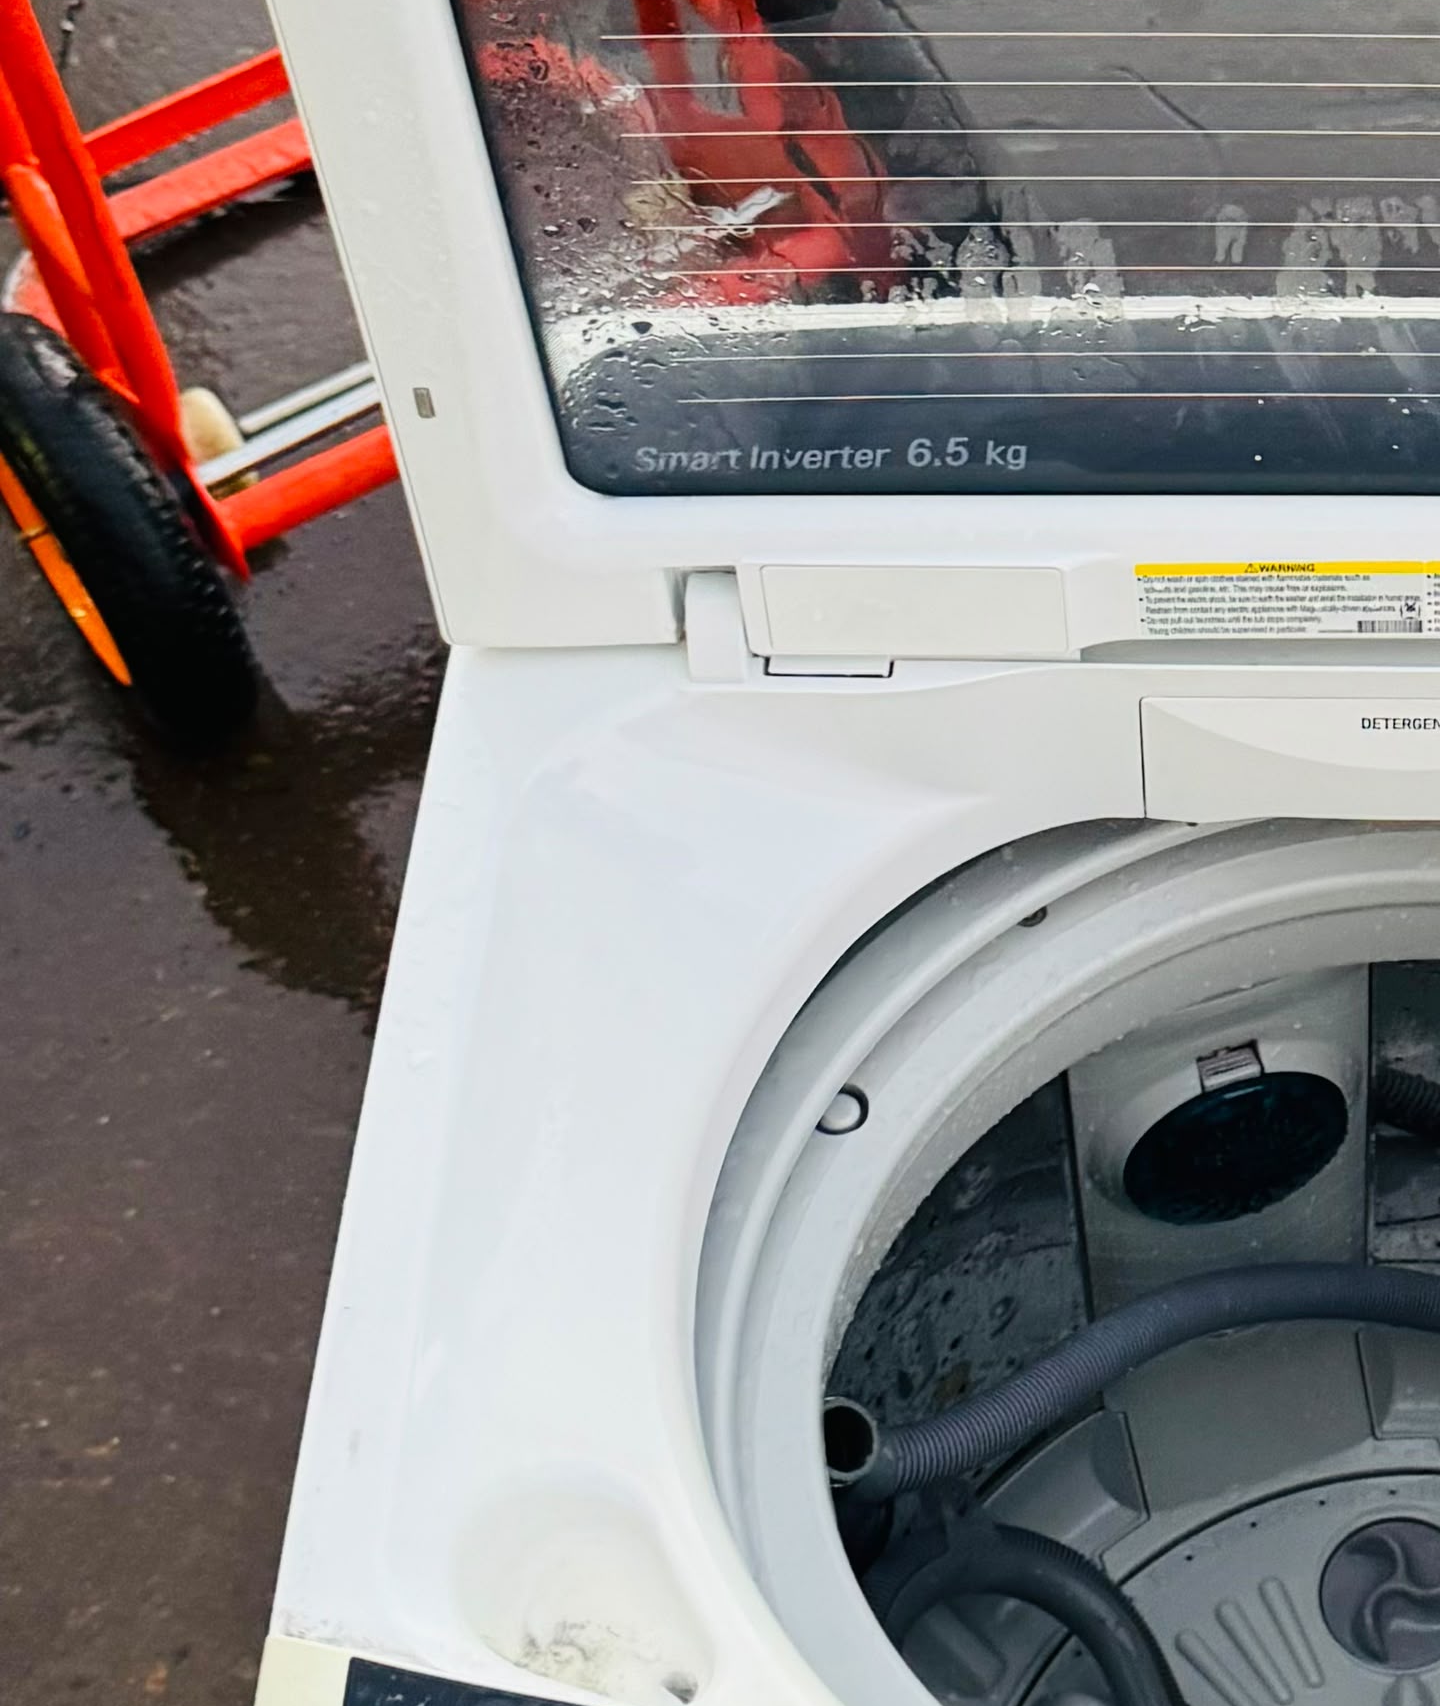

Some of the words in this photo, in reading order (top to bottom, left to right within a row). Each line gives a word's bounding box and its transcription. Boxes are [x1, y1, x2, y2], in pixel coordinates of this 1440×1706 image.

[635, 443, 741, 474] Smart
[750, 443, 891, 471] Inverter
[906, 437, 969, 468] 6.5
[986, 440, 1028, 472] kg
[1259, 563, 1315, 573] WARNING
